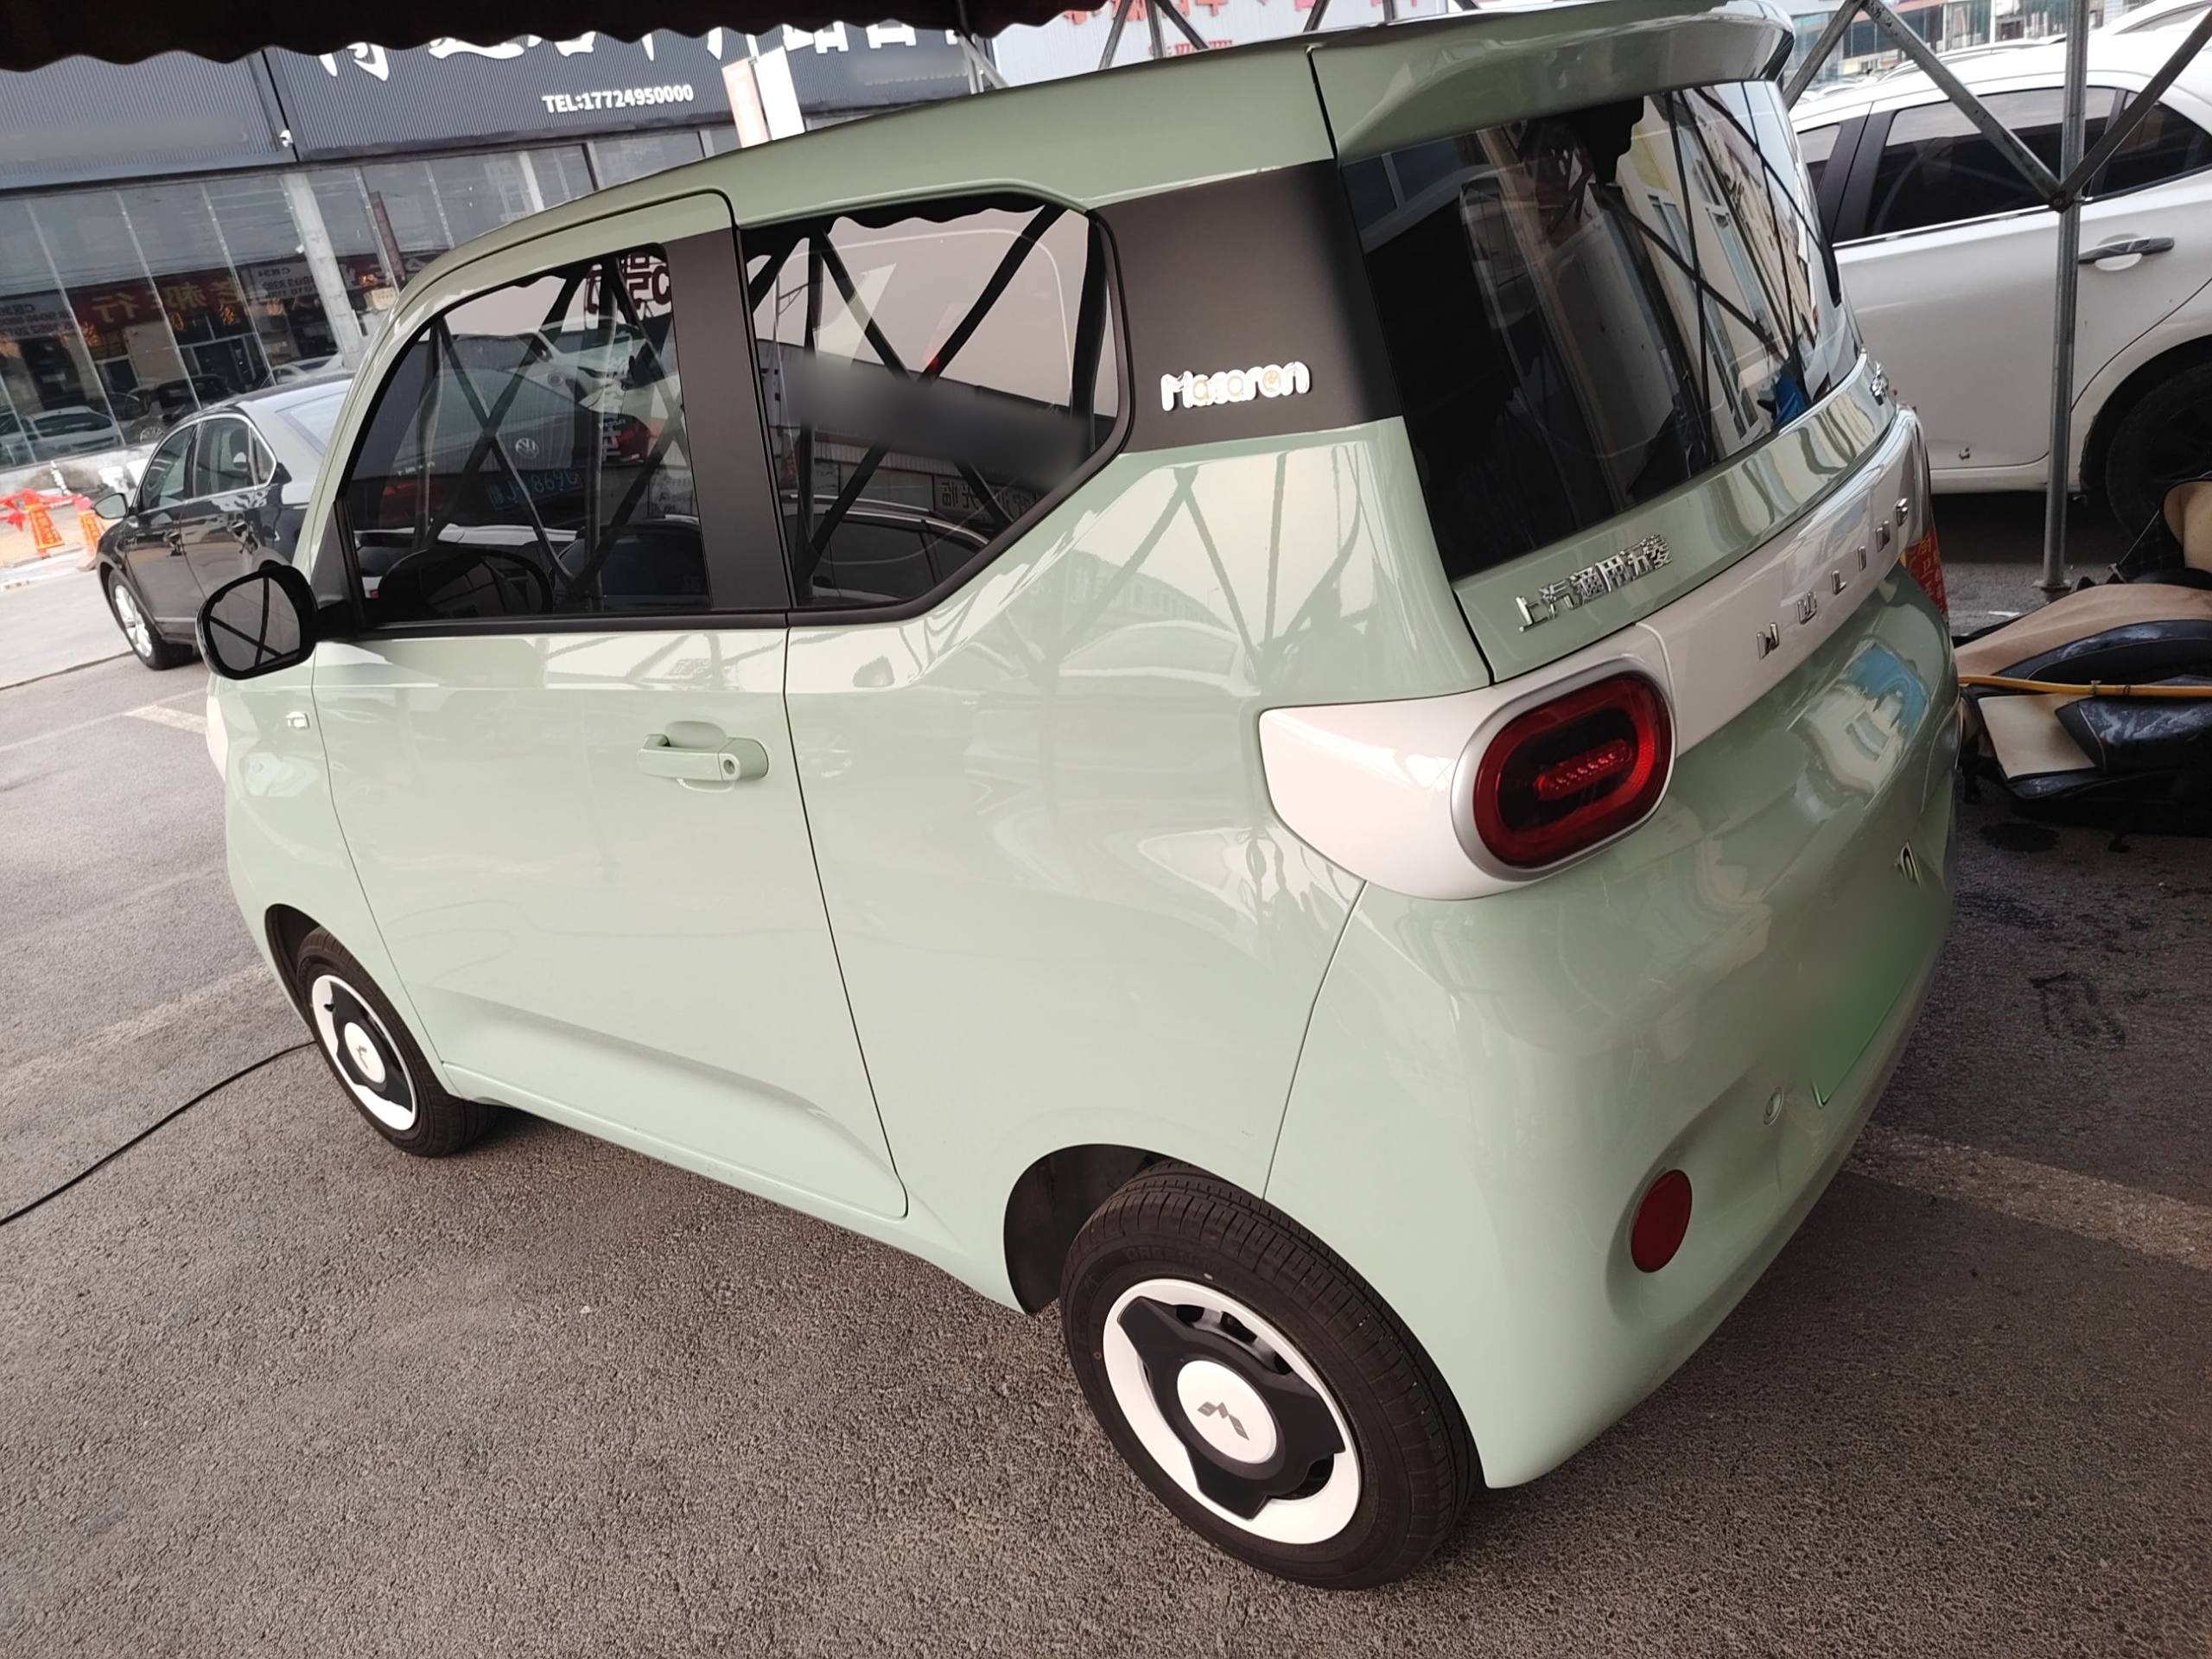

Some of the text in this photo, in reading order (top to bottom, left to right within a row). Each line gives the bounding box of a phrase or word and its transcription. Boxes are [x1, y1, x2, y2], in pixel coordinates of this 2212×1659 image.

[541, 84, 694, 114] TEL:17724950000
[1514, 532, 1673, 632] 上汽通用五菱
